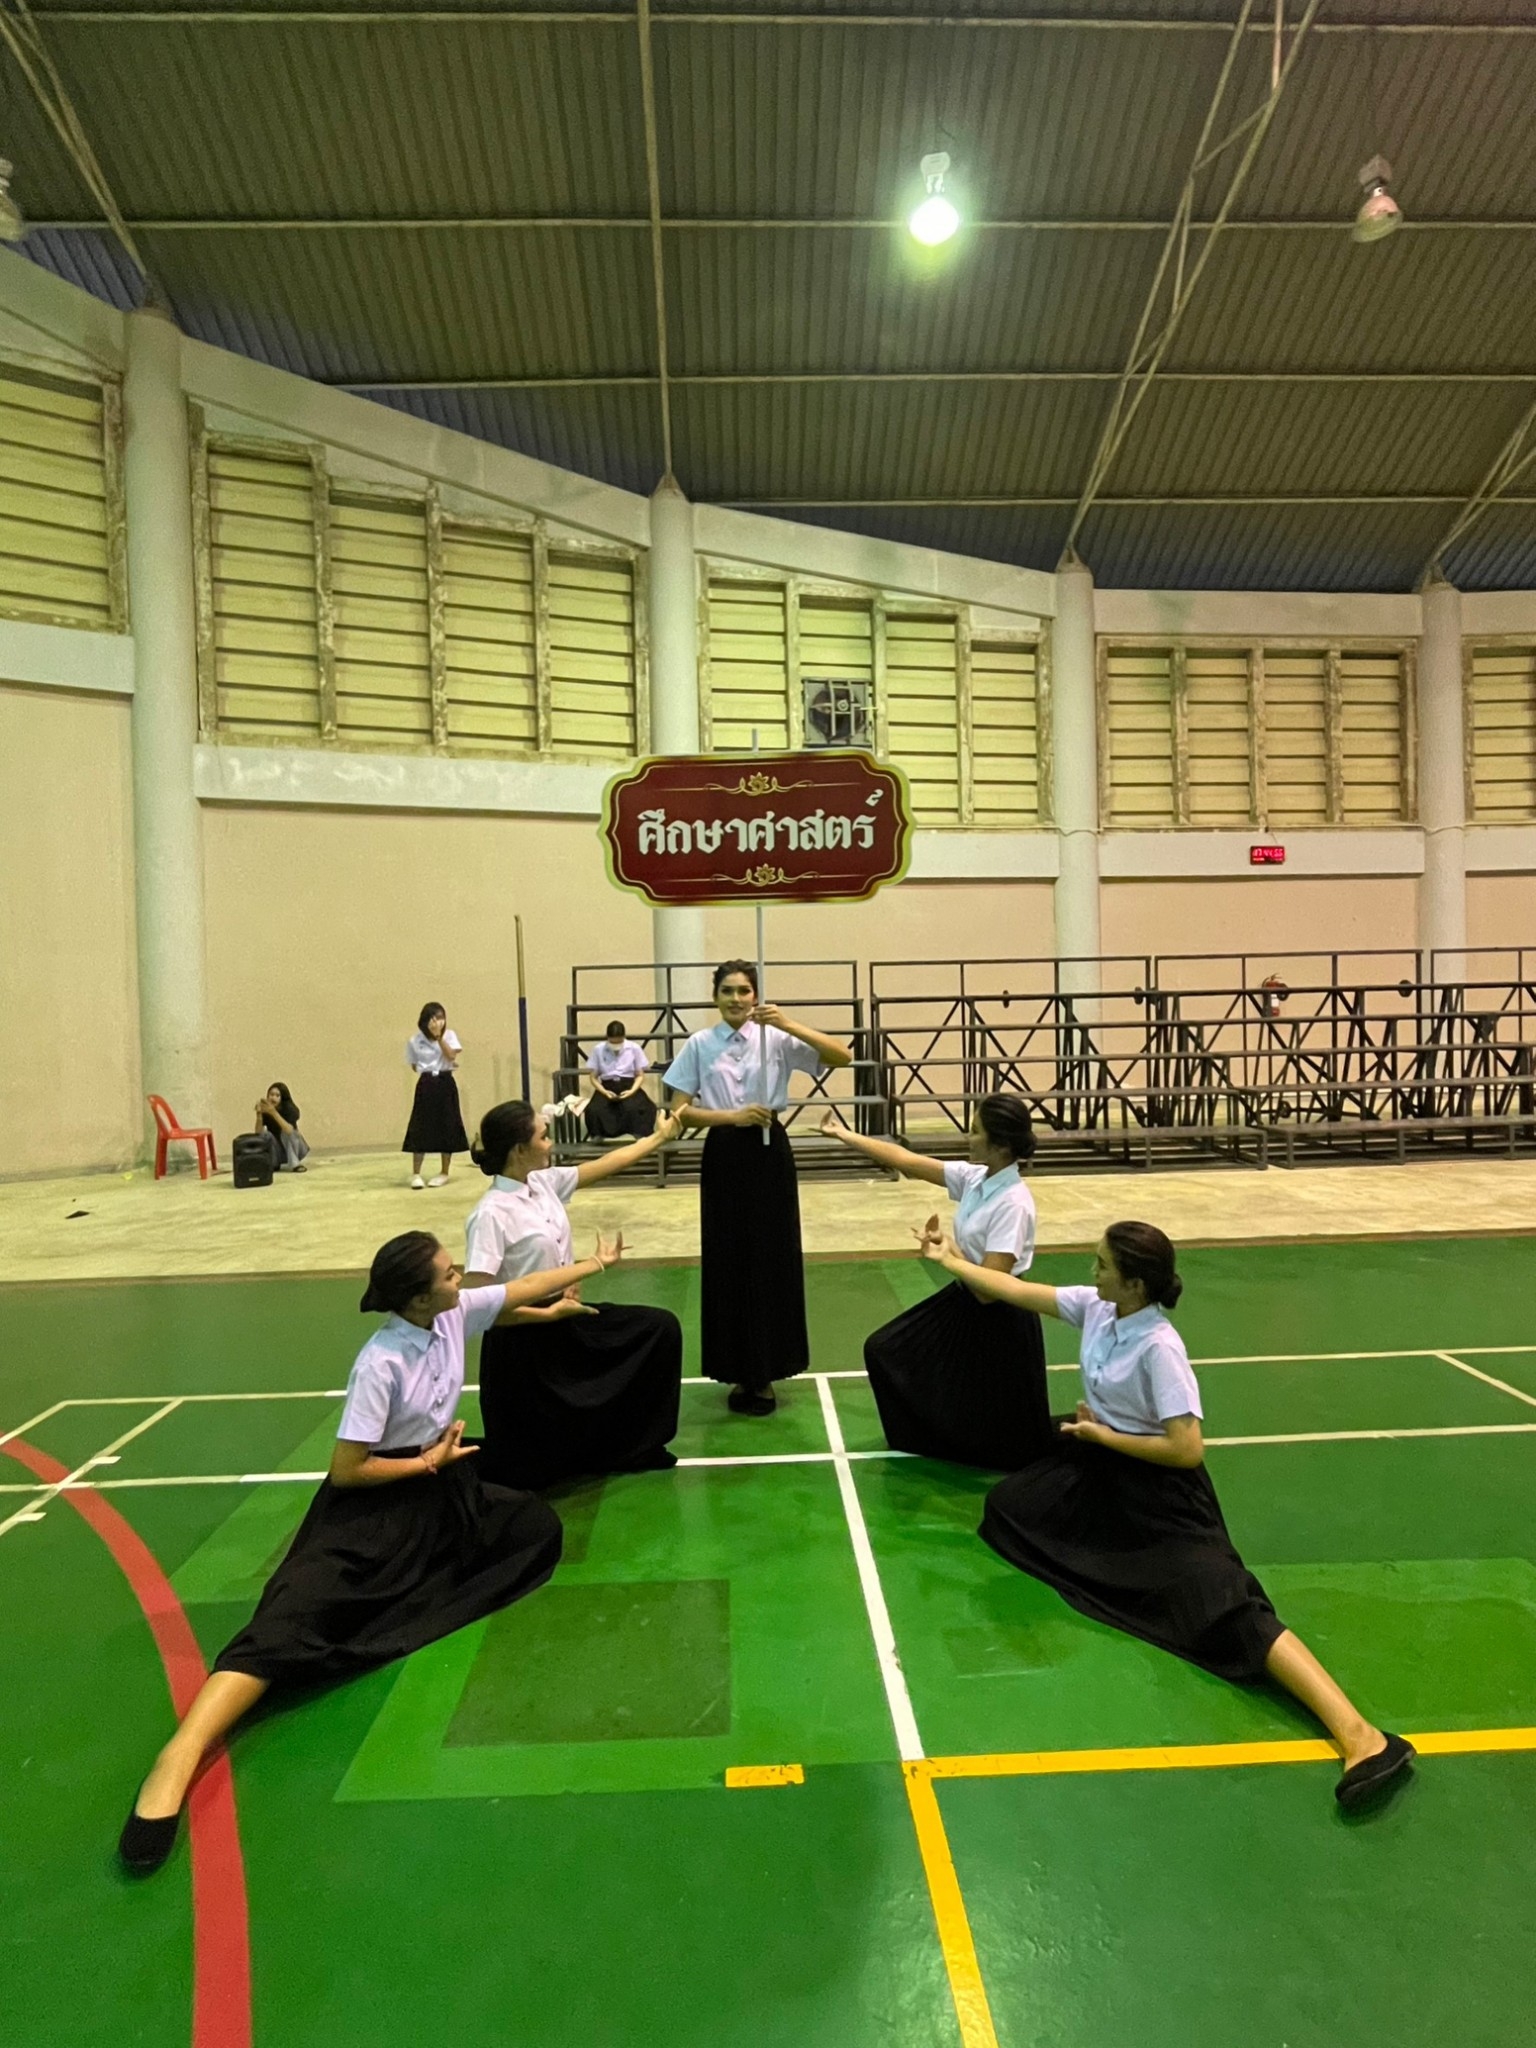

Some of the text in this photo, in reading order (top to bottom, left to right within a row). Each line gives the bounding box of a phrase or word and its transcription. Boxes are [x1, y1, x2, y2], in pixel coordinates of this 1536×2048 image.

[637, 789, 883, 855] ศึกษาศาสตร์
